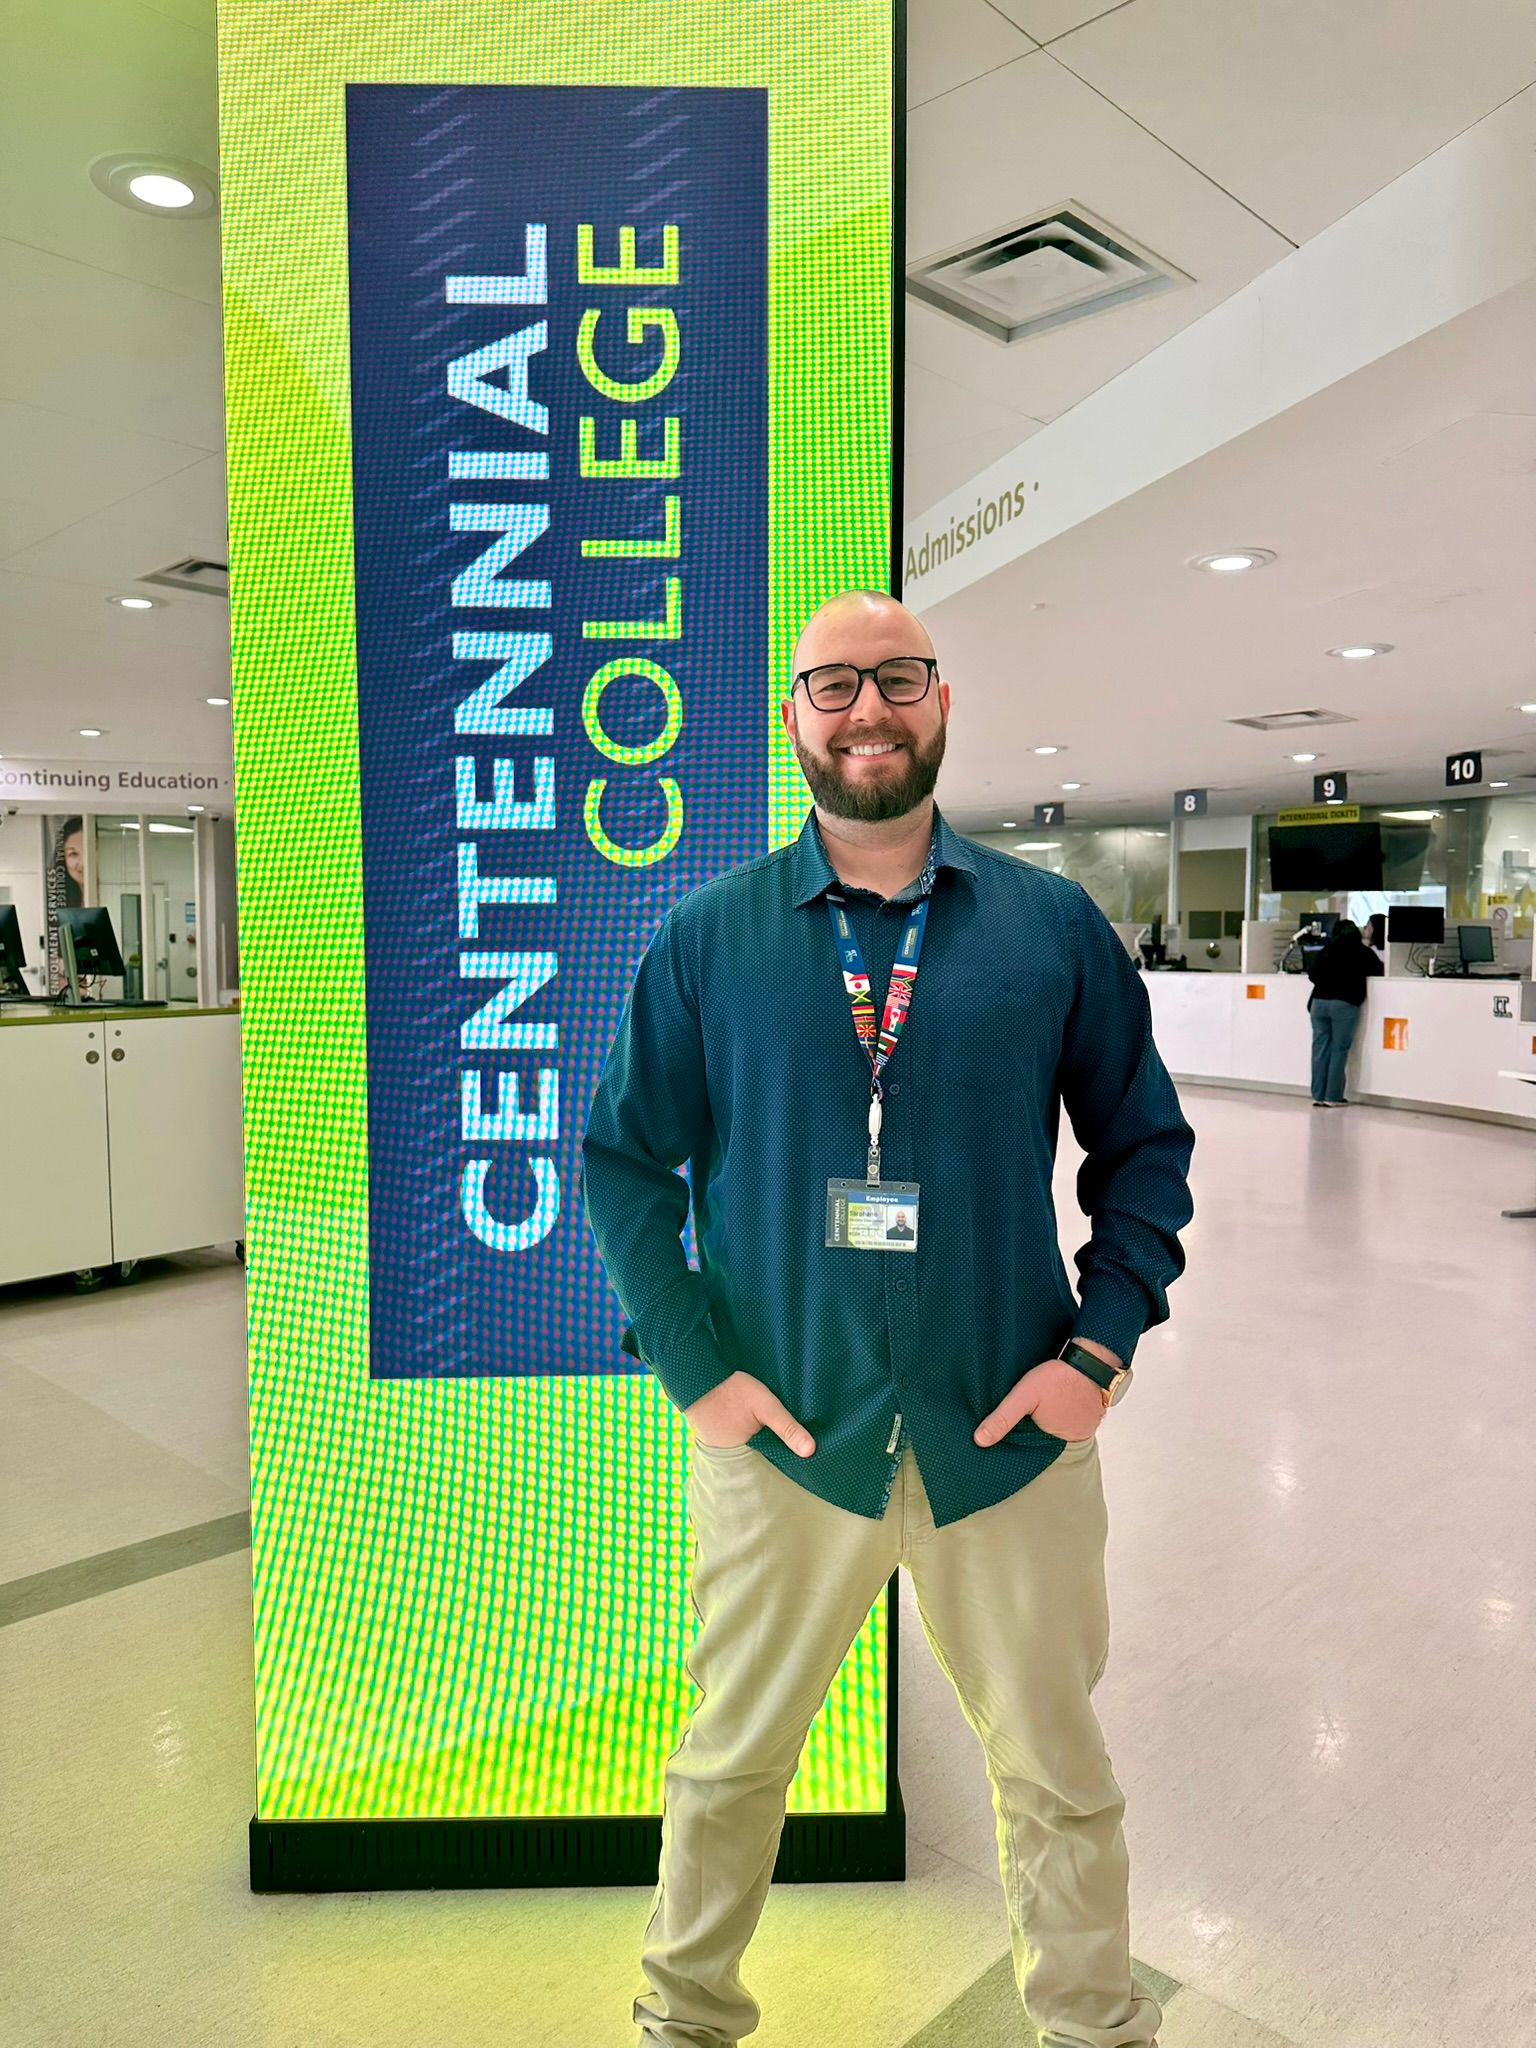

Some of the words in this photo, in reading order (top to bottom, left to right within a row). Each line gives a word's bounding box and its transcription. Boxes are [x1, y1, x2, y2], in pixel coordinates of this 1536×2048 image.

[904, 481, 1025, 587] Admissions
[577, 224, 684, 868] COLLEGE
[445, 223, 562, 1252] CENTENNIAL
[1451, 758, 1475, 780] 10
[118, 771, 218, 790] Education
[1323, 778, 1335, 797] 9
[1183, 795, 1196, 812] 8
[1043, 808, 1054, 824] 7
[48, 868, 58, 921] SERVICES
[49, 926, 60, 996] ENROLMENT
[865, 1195, 898, 1203] Employee
